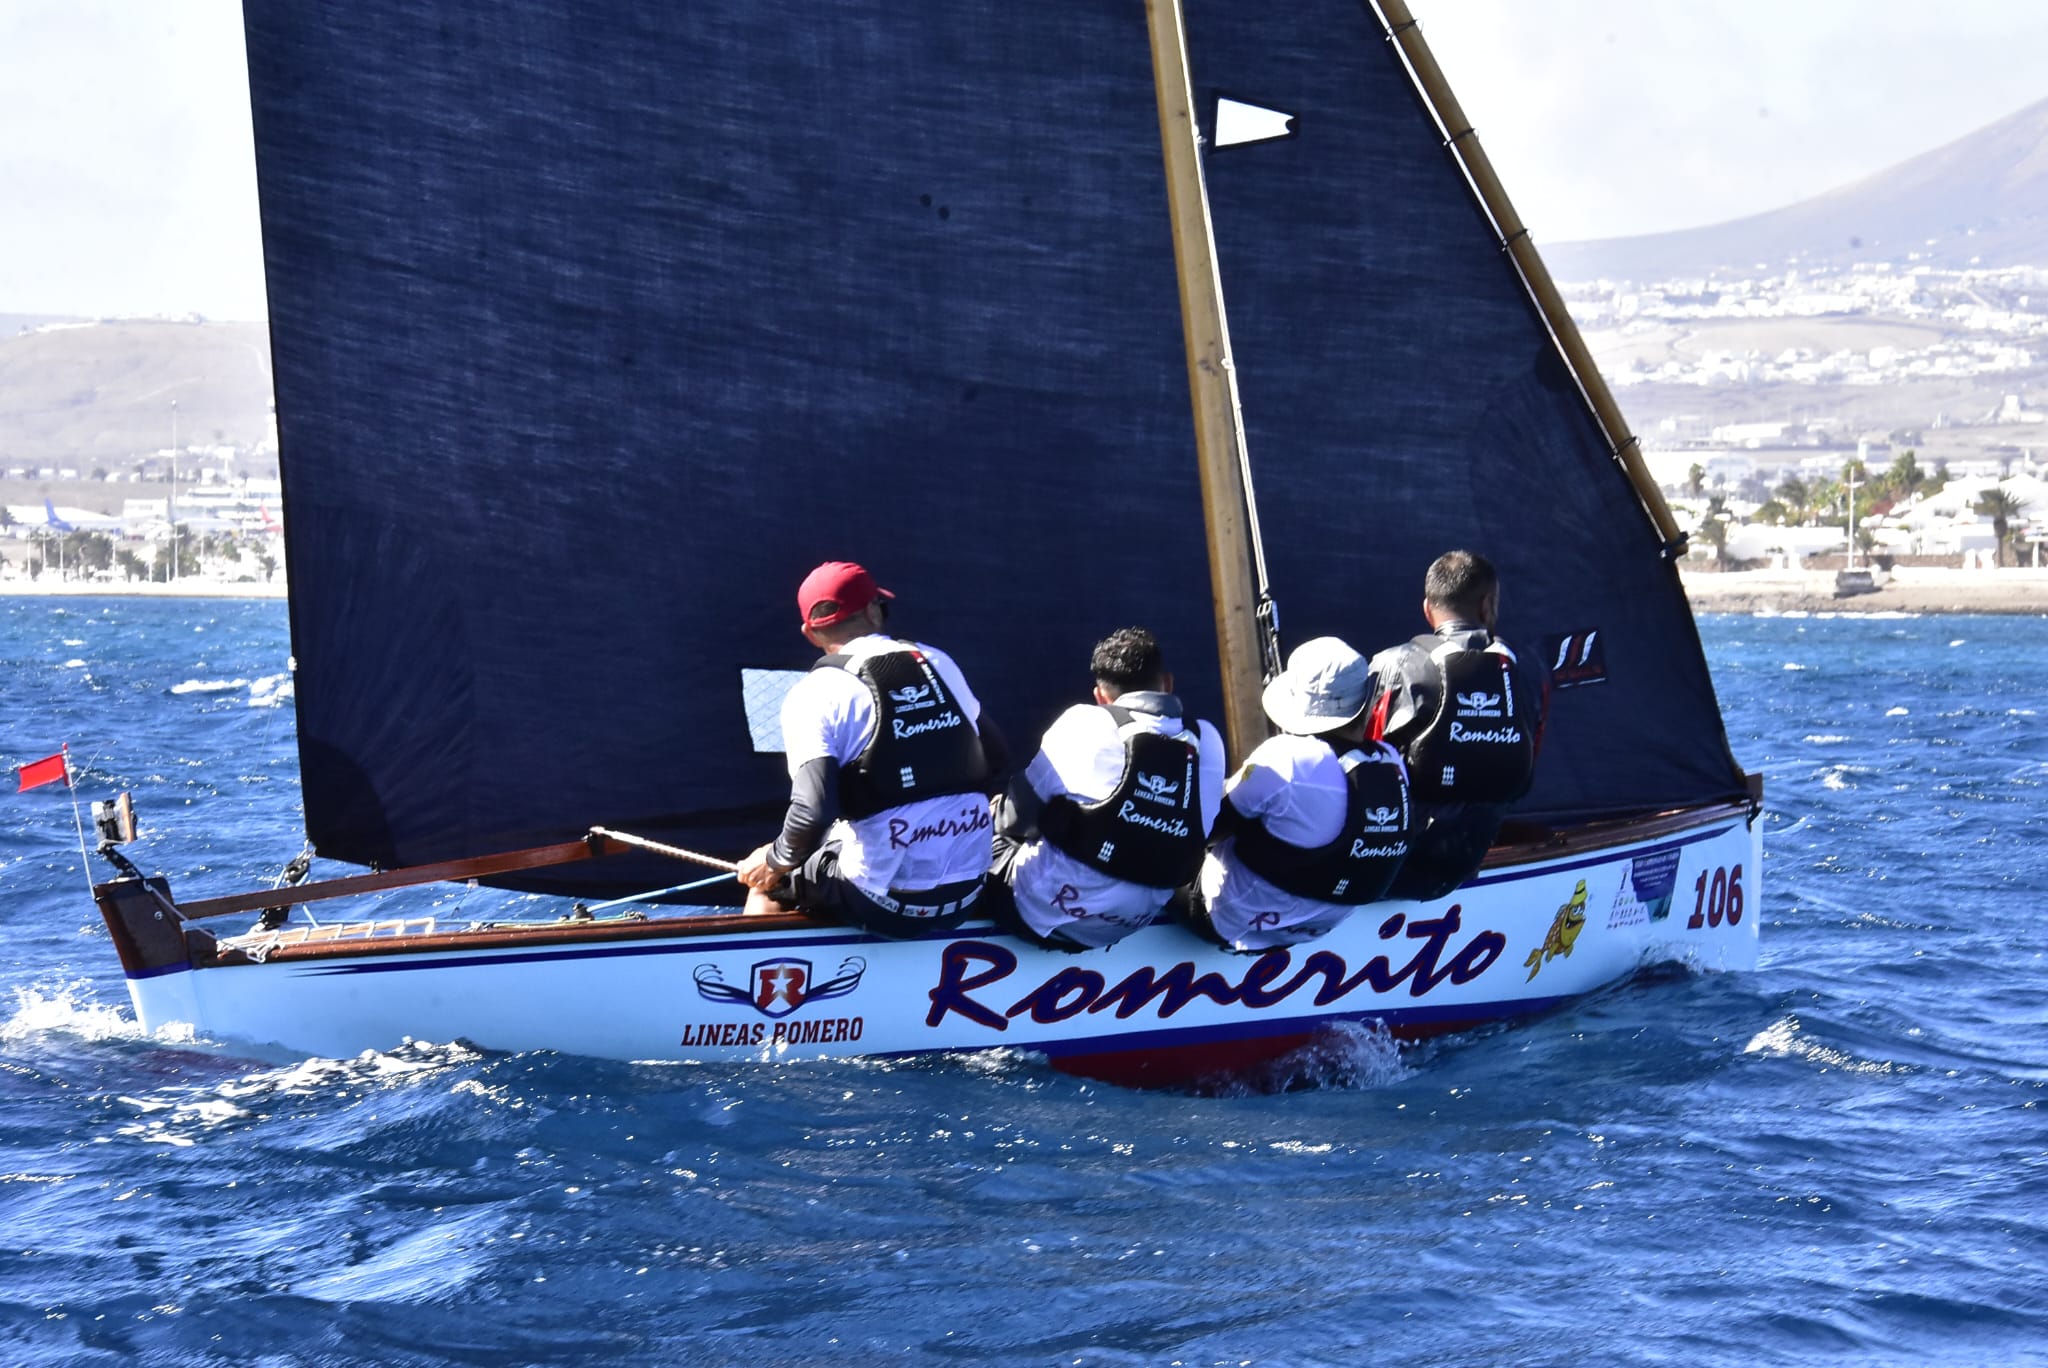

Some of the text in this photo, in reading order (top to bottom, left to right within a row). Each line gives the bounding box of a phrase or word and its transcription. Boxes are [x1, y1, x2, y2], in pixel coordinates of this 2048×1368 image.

[892, 711, 961, 739] Romerito
[1450, 721, 1521, 744] Romerito
[1117, 800, 1189, 837] Romerito
[1350, 838, 1408, 859] Romerito
[1687, 863, 1743, 930] 106
[925, 903, 1507, 1031] Romerito
[680, 1016, 864, 1046] LINEAS ROMERO
